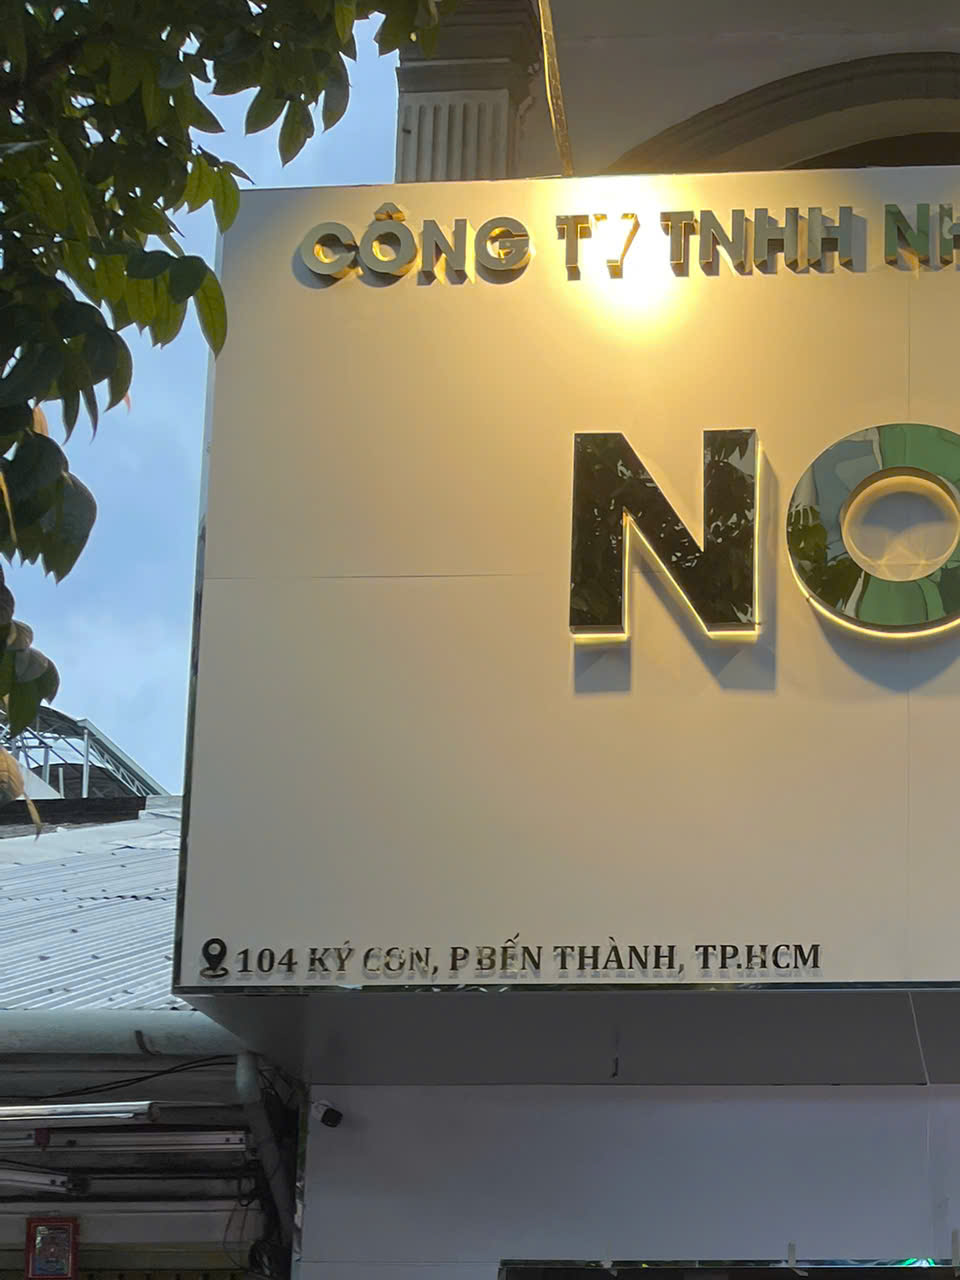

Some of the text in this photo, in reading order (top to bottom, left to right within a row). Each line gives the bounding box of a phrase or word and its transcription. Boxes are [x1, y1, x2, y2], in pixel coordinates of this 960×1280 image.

[301, 202, 530, 276] CÔNG
[660, 206, 855, 276] TNHH
[236, 948, 298, 973] 104
[307, 940, 353, 972] KÝ
[553, 936, 686, 974] THÀNH,
[695, 944, 821, 969] TP.HCM
